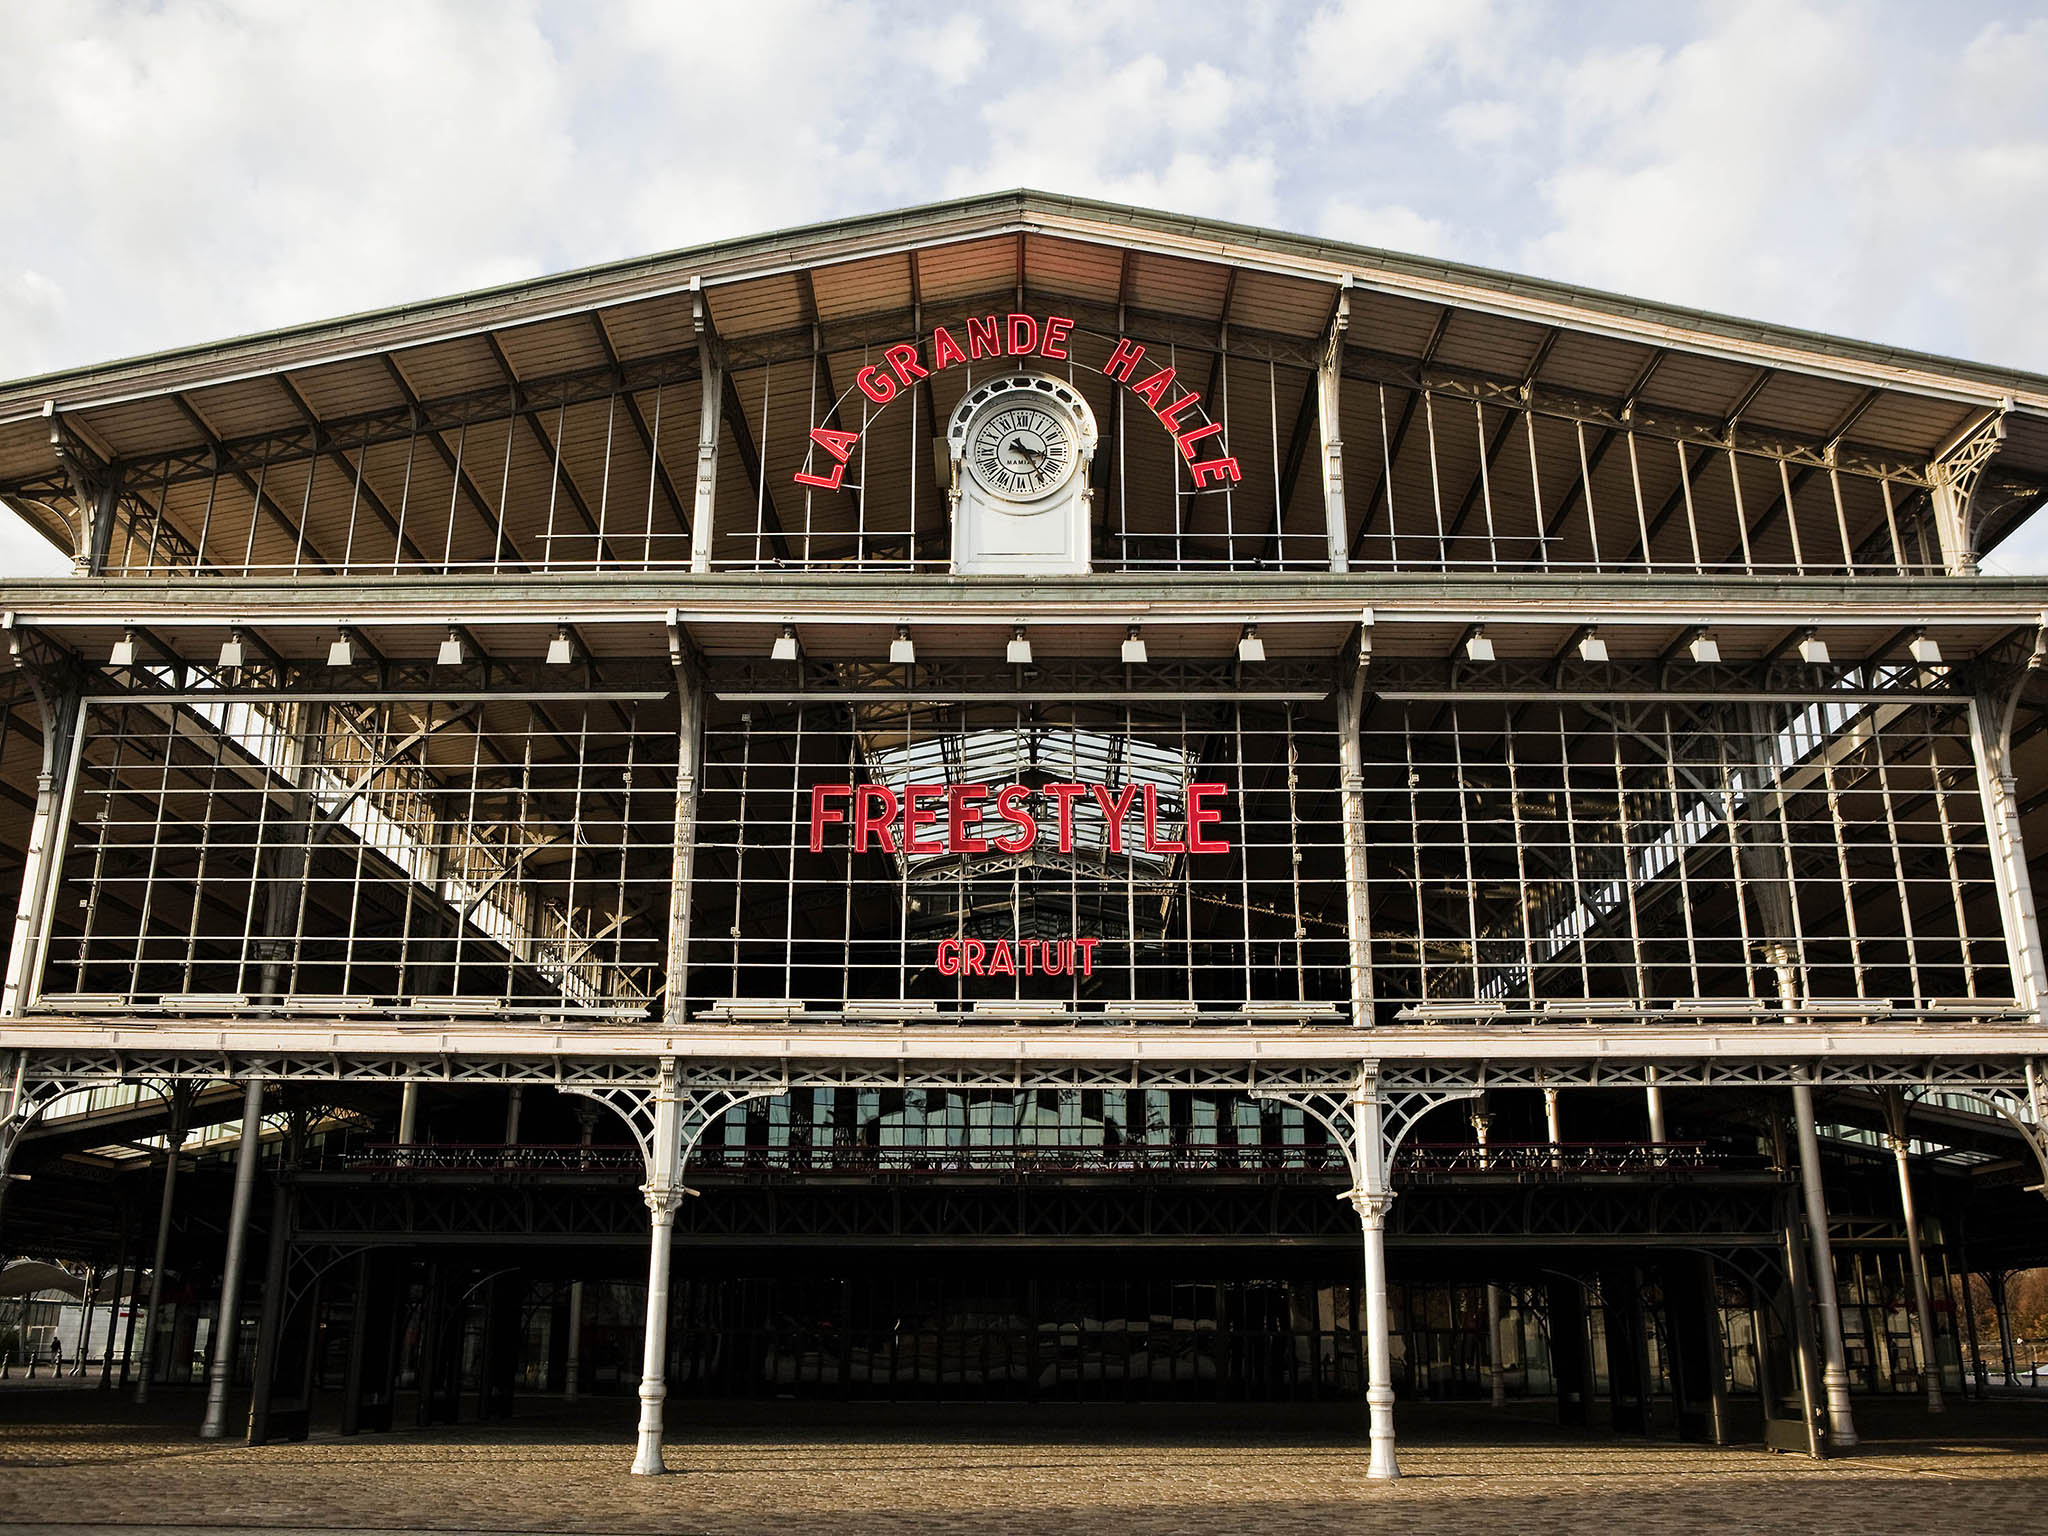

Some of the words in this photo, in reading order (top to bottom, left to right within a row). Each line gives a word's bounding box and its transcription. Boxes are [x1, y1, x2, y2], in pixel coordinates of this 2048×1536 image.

[794, 427, 860, 491] LA
[855, 313, 1075, 404] GRANDE
[1103, 337, 1243, 489] HALLE
[809, 783, 1230, 854] FREESTYLE
[936, 937, 1099, 977] GRATUIT
